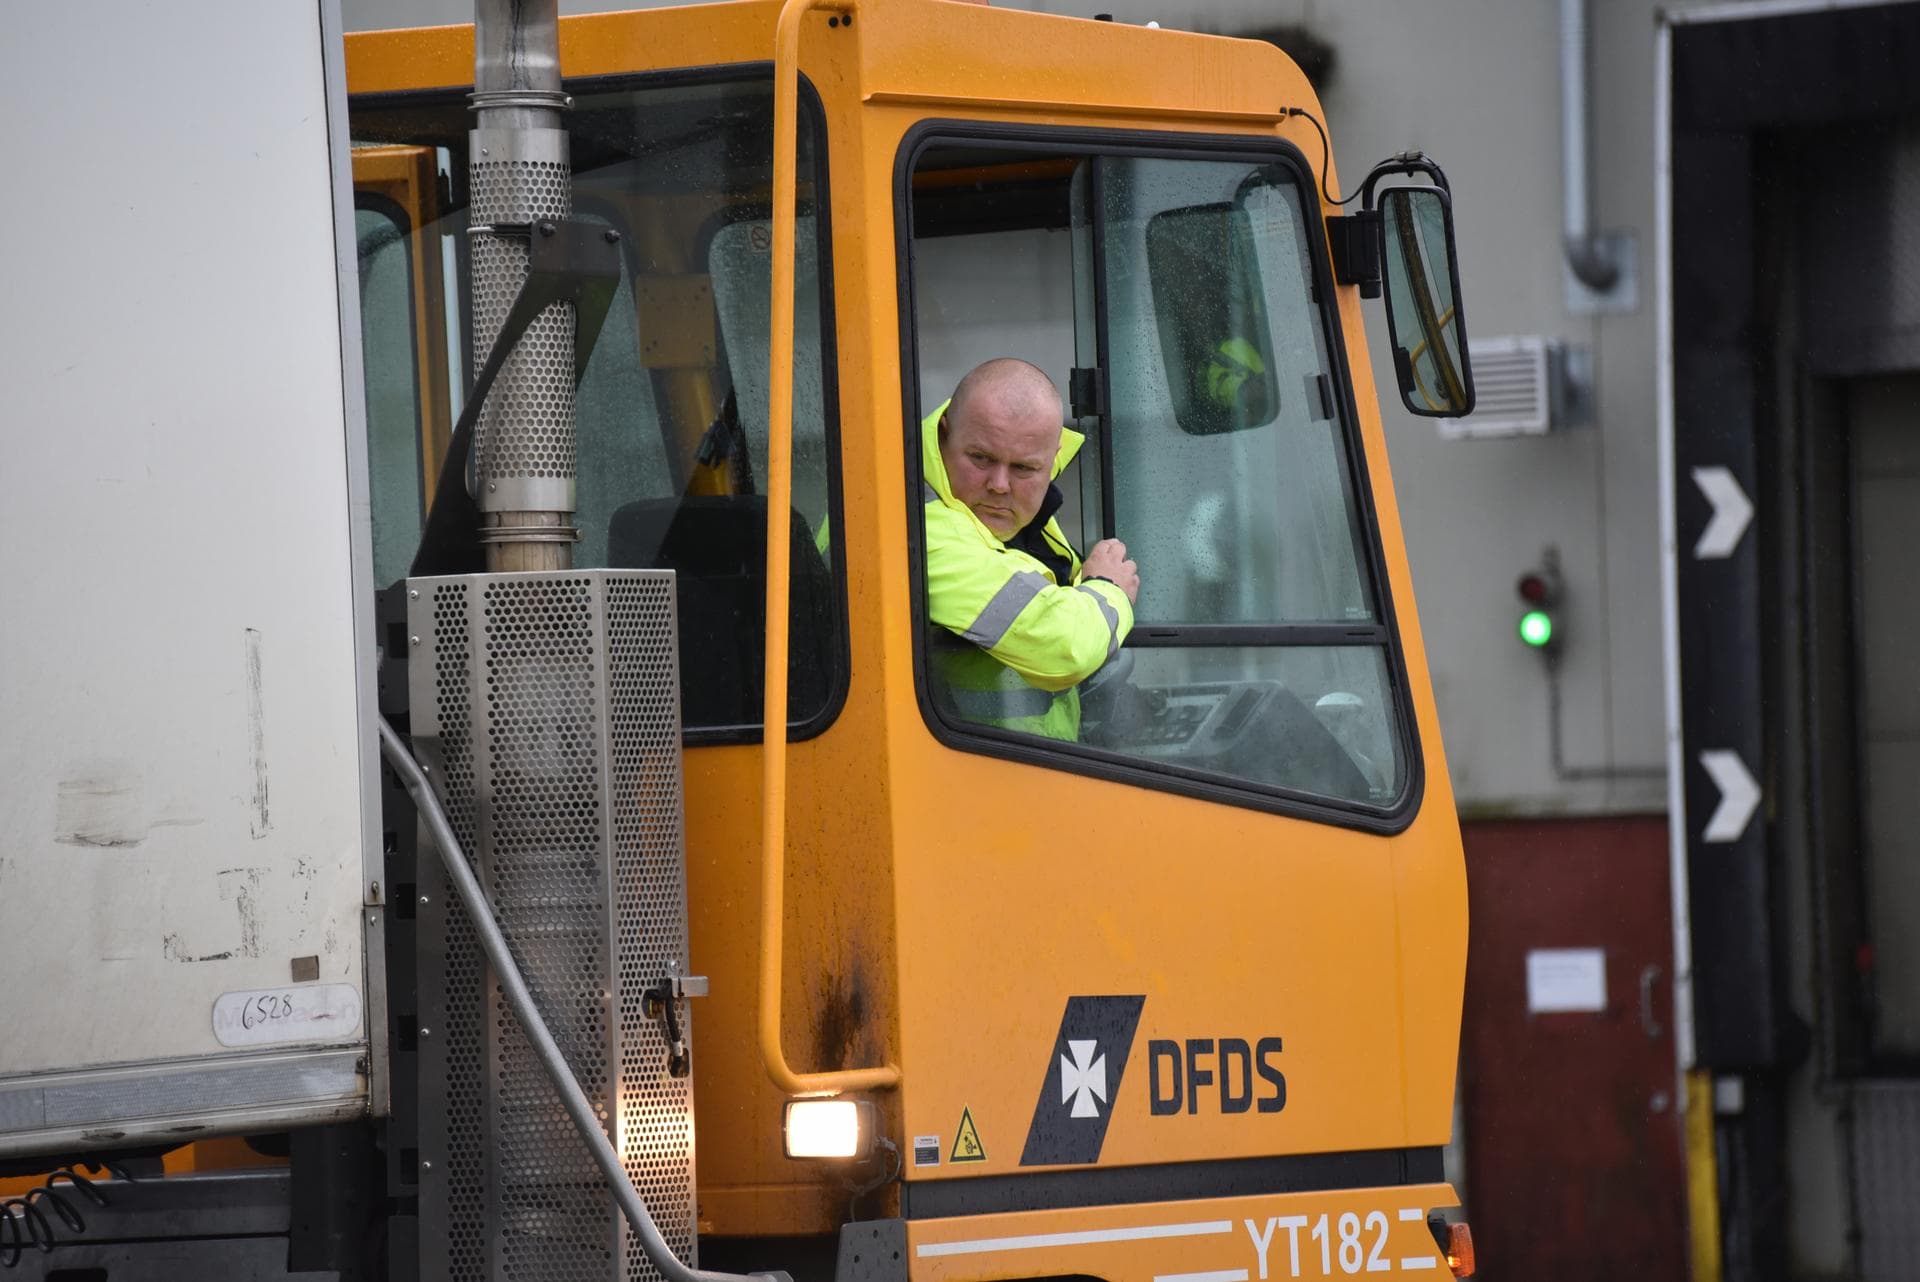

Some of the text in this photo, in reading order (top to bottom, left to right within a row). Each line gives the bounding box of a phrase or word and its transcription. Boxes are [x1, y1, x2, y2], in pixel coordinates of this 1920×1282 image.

[242, 994, 293, 1030] 6528
[1148, 1037, 1287, 1116] DFDS
[1244, 1210, 1391, 1280] YT182
